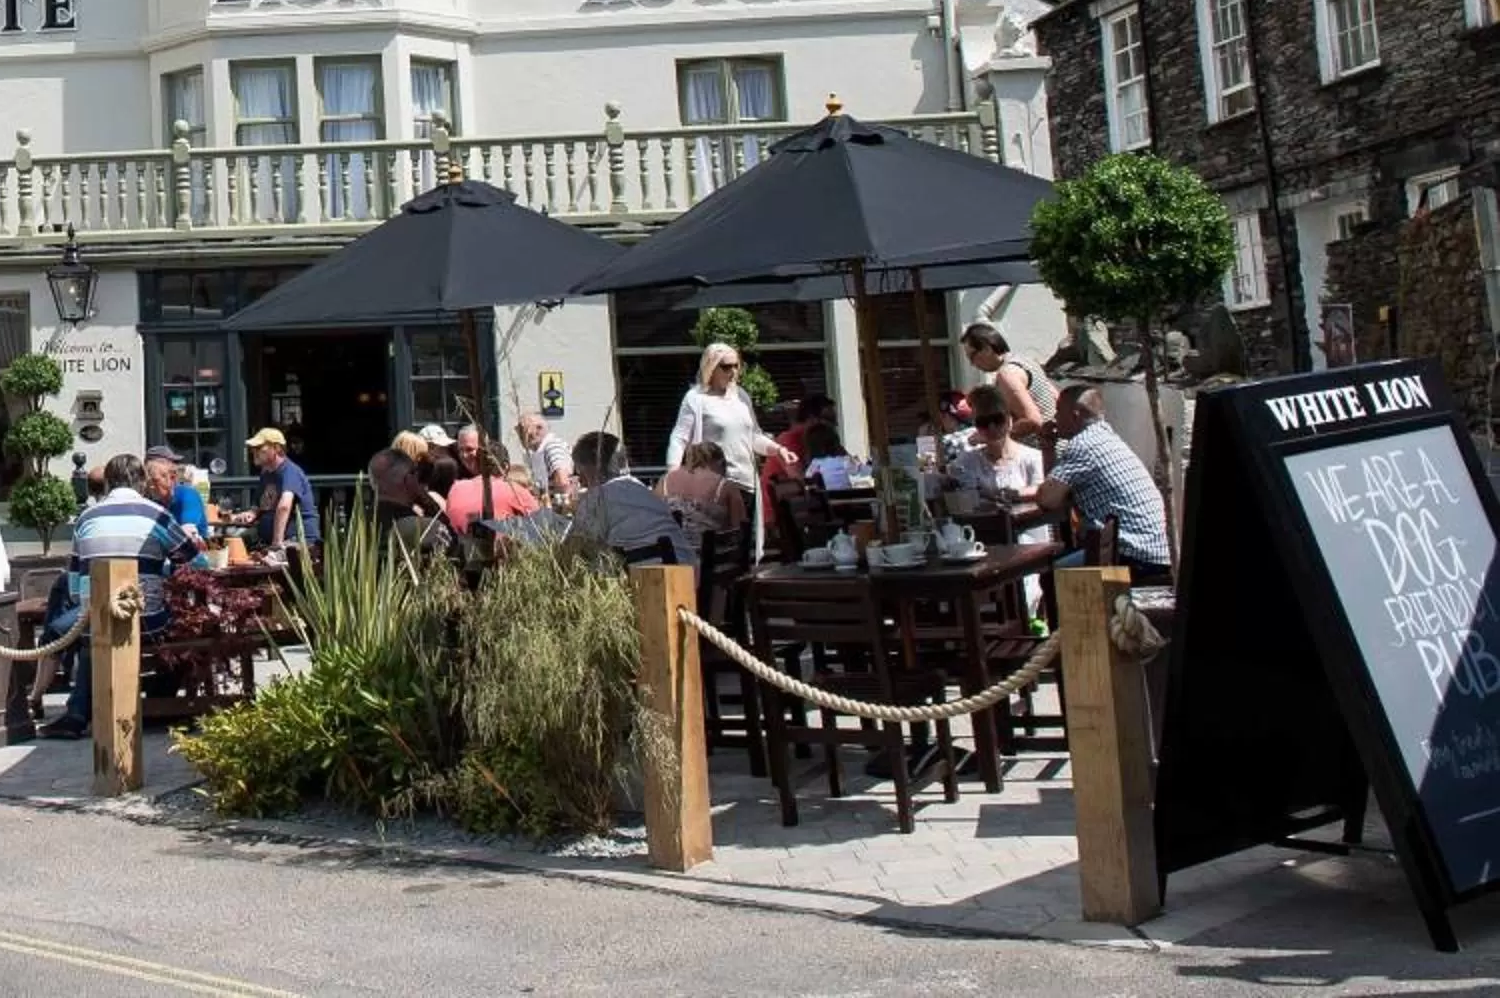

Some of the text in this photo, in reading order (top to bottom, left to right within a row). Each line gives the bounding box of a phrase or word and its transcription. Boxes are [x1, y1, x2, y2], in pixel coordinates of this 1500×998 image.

[93, 357, 131, 373] LION
[1265, 375, 1432, 431] WHITE LION
[1305, 447, 1460, 523] WE ARE A
[1363, 508, 1467, 595] DOG
[1384, 571, 1498, 647] FRIENDLY
[1416, 630, 1500, 702] PUB
